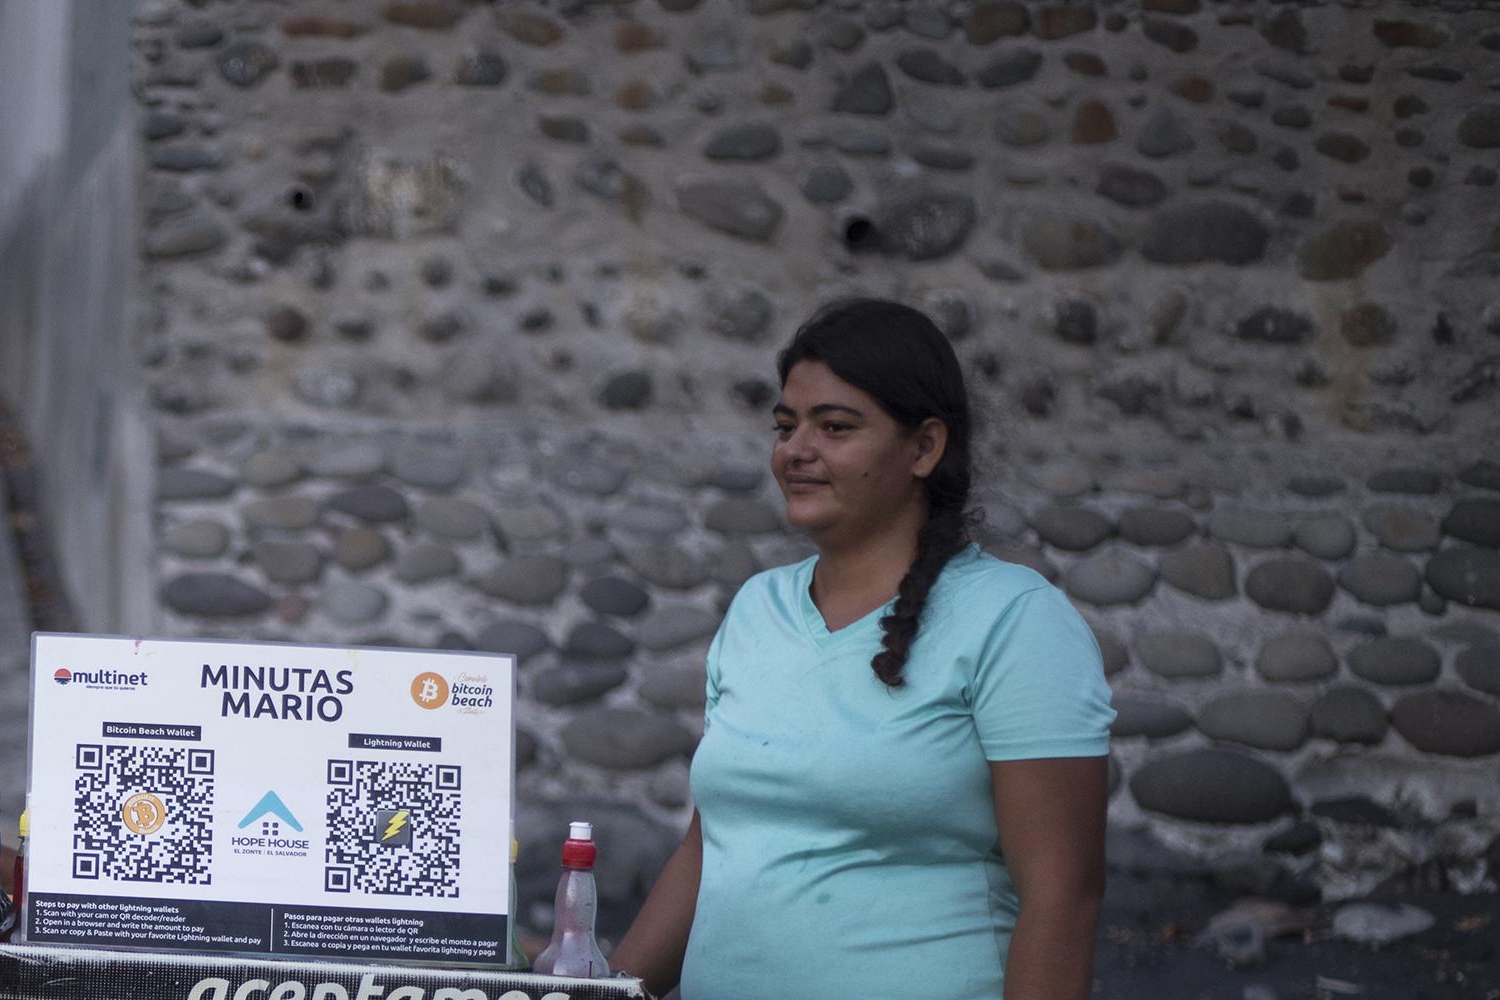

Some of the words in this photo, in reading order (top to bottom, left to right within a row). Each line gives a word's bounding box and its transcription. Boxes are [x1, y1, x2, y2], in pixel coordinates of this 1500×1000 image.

[73, 669, 147, 685] multinet
[201, 665, 354, 694] MINUTAS
[452, 683, 492, 695] bitcoin
[452, 694, 492, 707] beach
[222, 692, 342, 722] MARIO
[107, 726, 136, 734] Bitcoin
[139, 727, 164, 735] Beach
[364, 739, 402, 748] Lightning
[232, 837, 265, 846] HOPE
[268, 839, 309, 849] HOUSE
[120, 905, 151, 913] lightning
[120, 913, 130, 921] QR
[132, 914, 186, 923] decoder/reader
[323, 915, 343, 923] pagar
[392, 918, 423, 927] lightning
[292, 922, 319, 930] Escanea
[177, 934, 210, 942] Lightning
[317, 932, 348, 940] dirección
[370, 935, 406, 943] navegador
[478, 940, 498, 948] pagar
[413, 945, 440, 953] favorita
[441, 947, 472, 955] lightning
